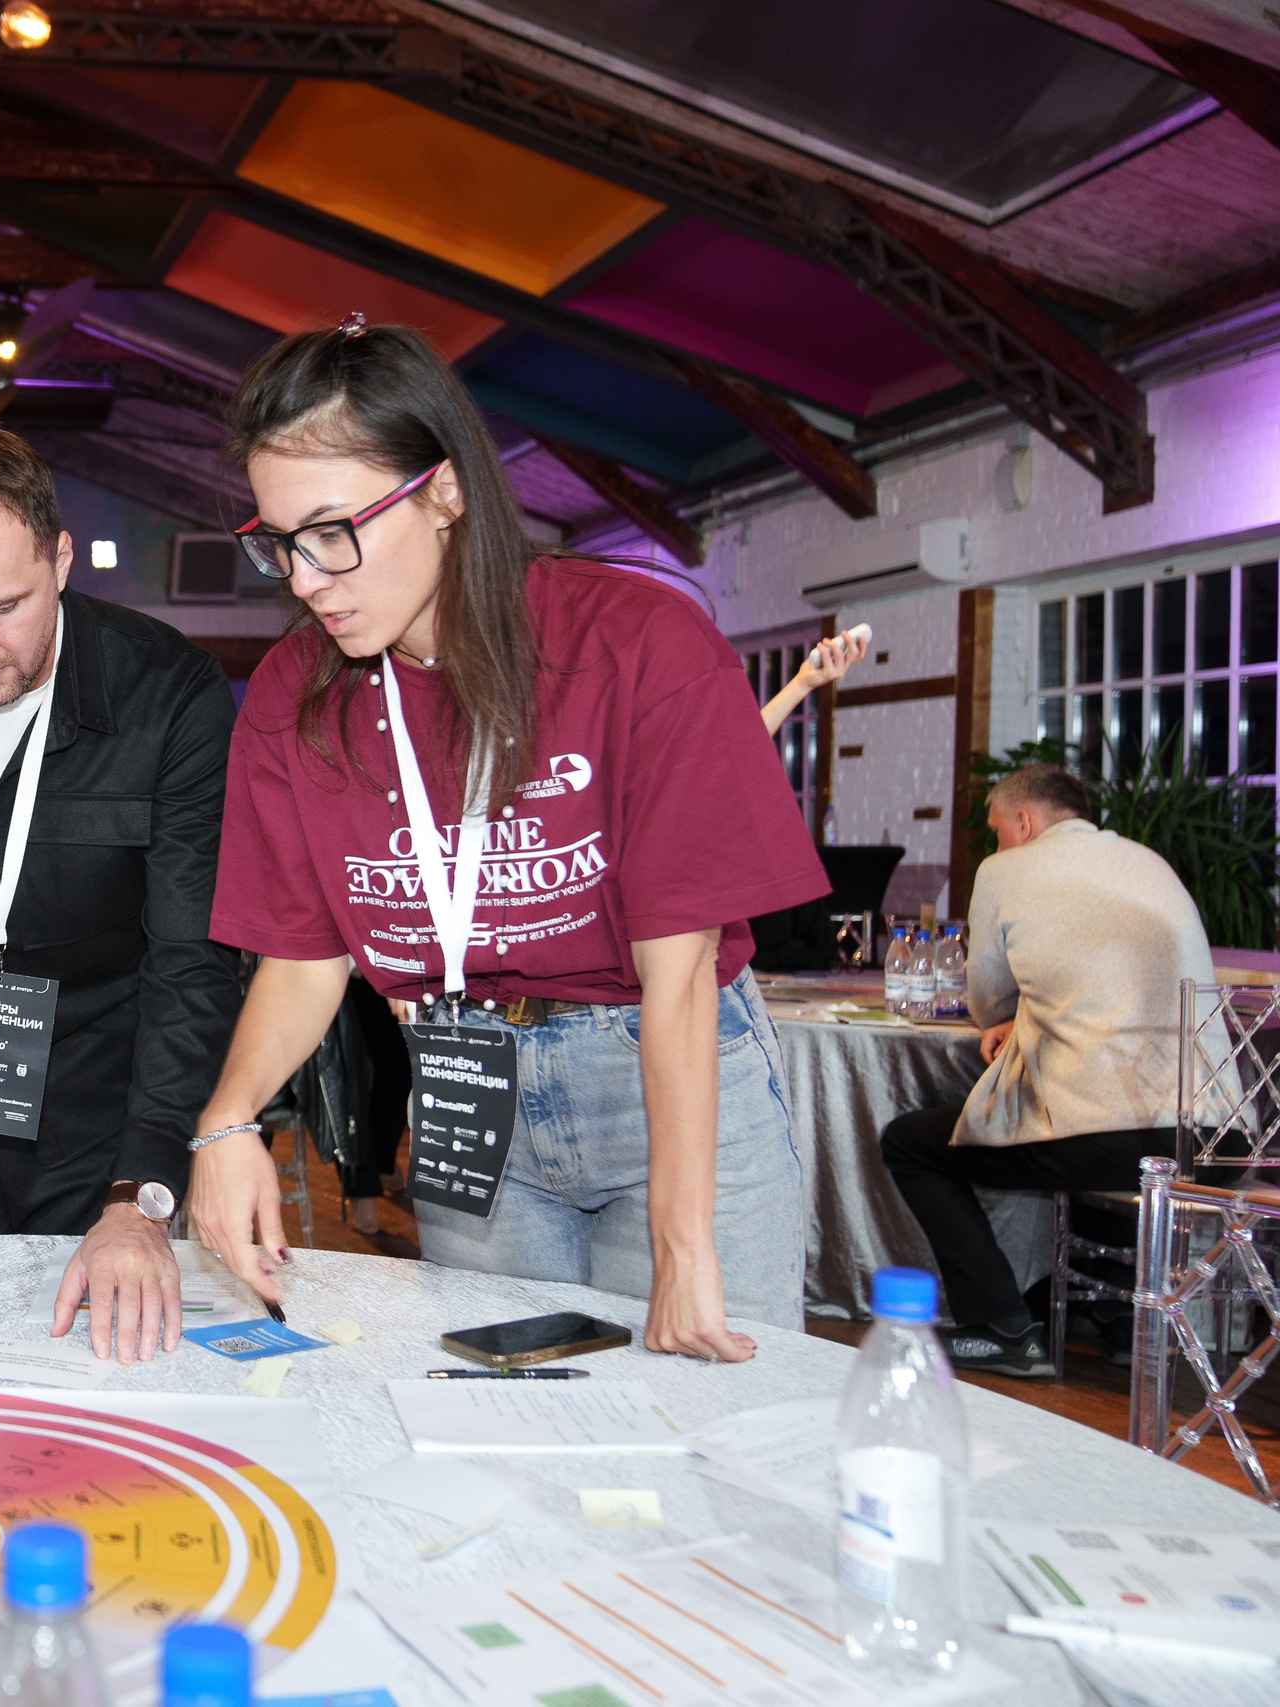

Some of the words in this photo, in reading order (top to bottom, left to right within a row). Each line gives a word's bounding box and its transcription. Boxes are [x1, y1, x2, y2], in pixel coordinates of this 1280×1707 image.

[522, 785, 567, 800] COOKIES
[542, 777, 564, 789] ALL
[388, 816, 547, 859] ONINE
[345, 843, 609, 898] WORKACE
[348, 896, 363, 904] I'M
[364, 897, 385, 907] HERE
[386, 900, 399, 909] TO
[492, 898, 510, 907] THE
[510, 890, 560, 907] SUPPORT
[560, 883, 585, 896] YOU
[375, 951, 425, 970] Communication
[420, 1053, 482, 1073] ПАРТНЁРЫ
[421, 1066, 509, 1090] КОНФЕРЕНЦИИ
